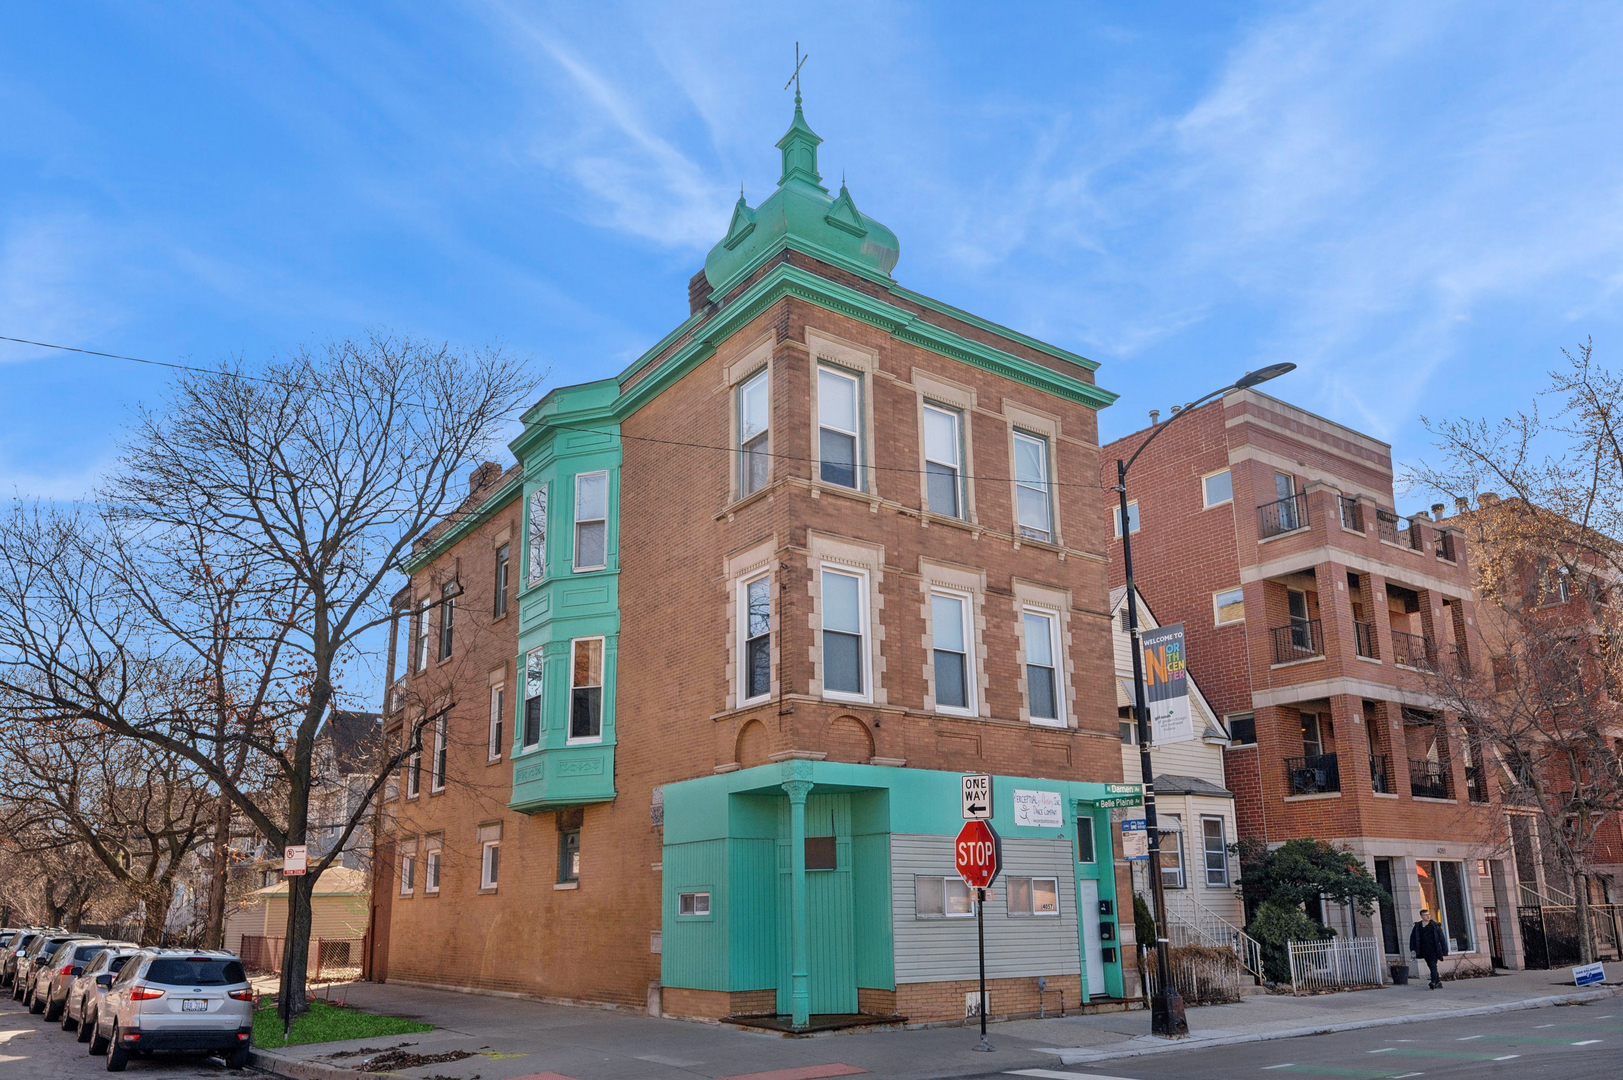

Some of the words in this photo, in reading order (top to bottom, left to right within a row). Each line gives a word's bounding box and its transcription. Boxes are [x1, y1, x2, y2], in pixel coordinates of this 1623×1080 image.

[1144, 634, 1173, 646] WELCOME
[965, 779, 987, 789] ONE
[1111, 785, 1134, 793] Damen
[965, 790, 987, 801] WAY
[1100, 800, 1115, 808] Belle
[1116, 798, 1134, 806] Plaine
[958, 841, 993, 866] STOP
